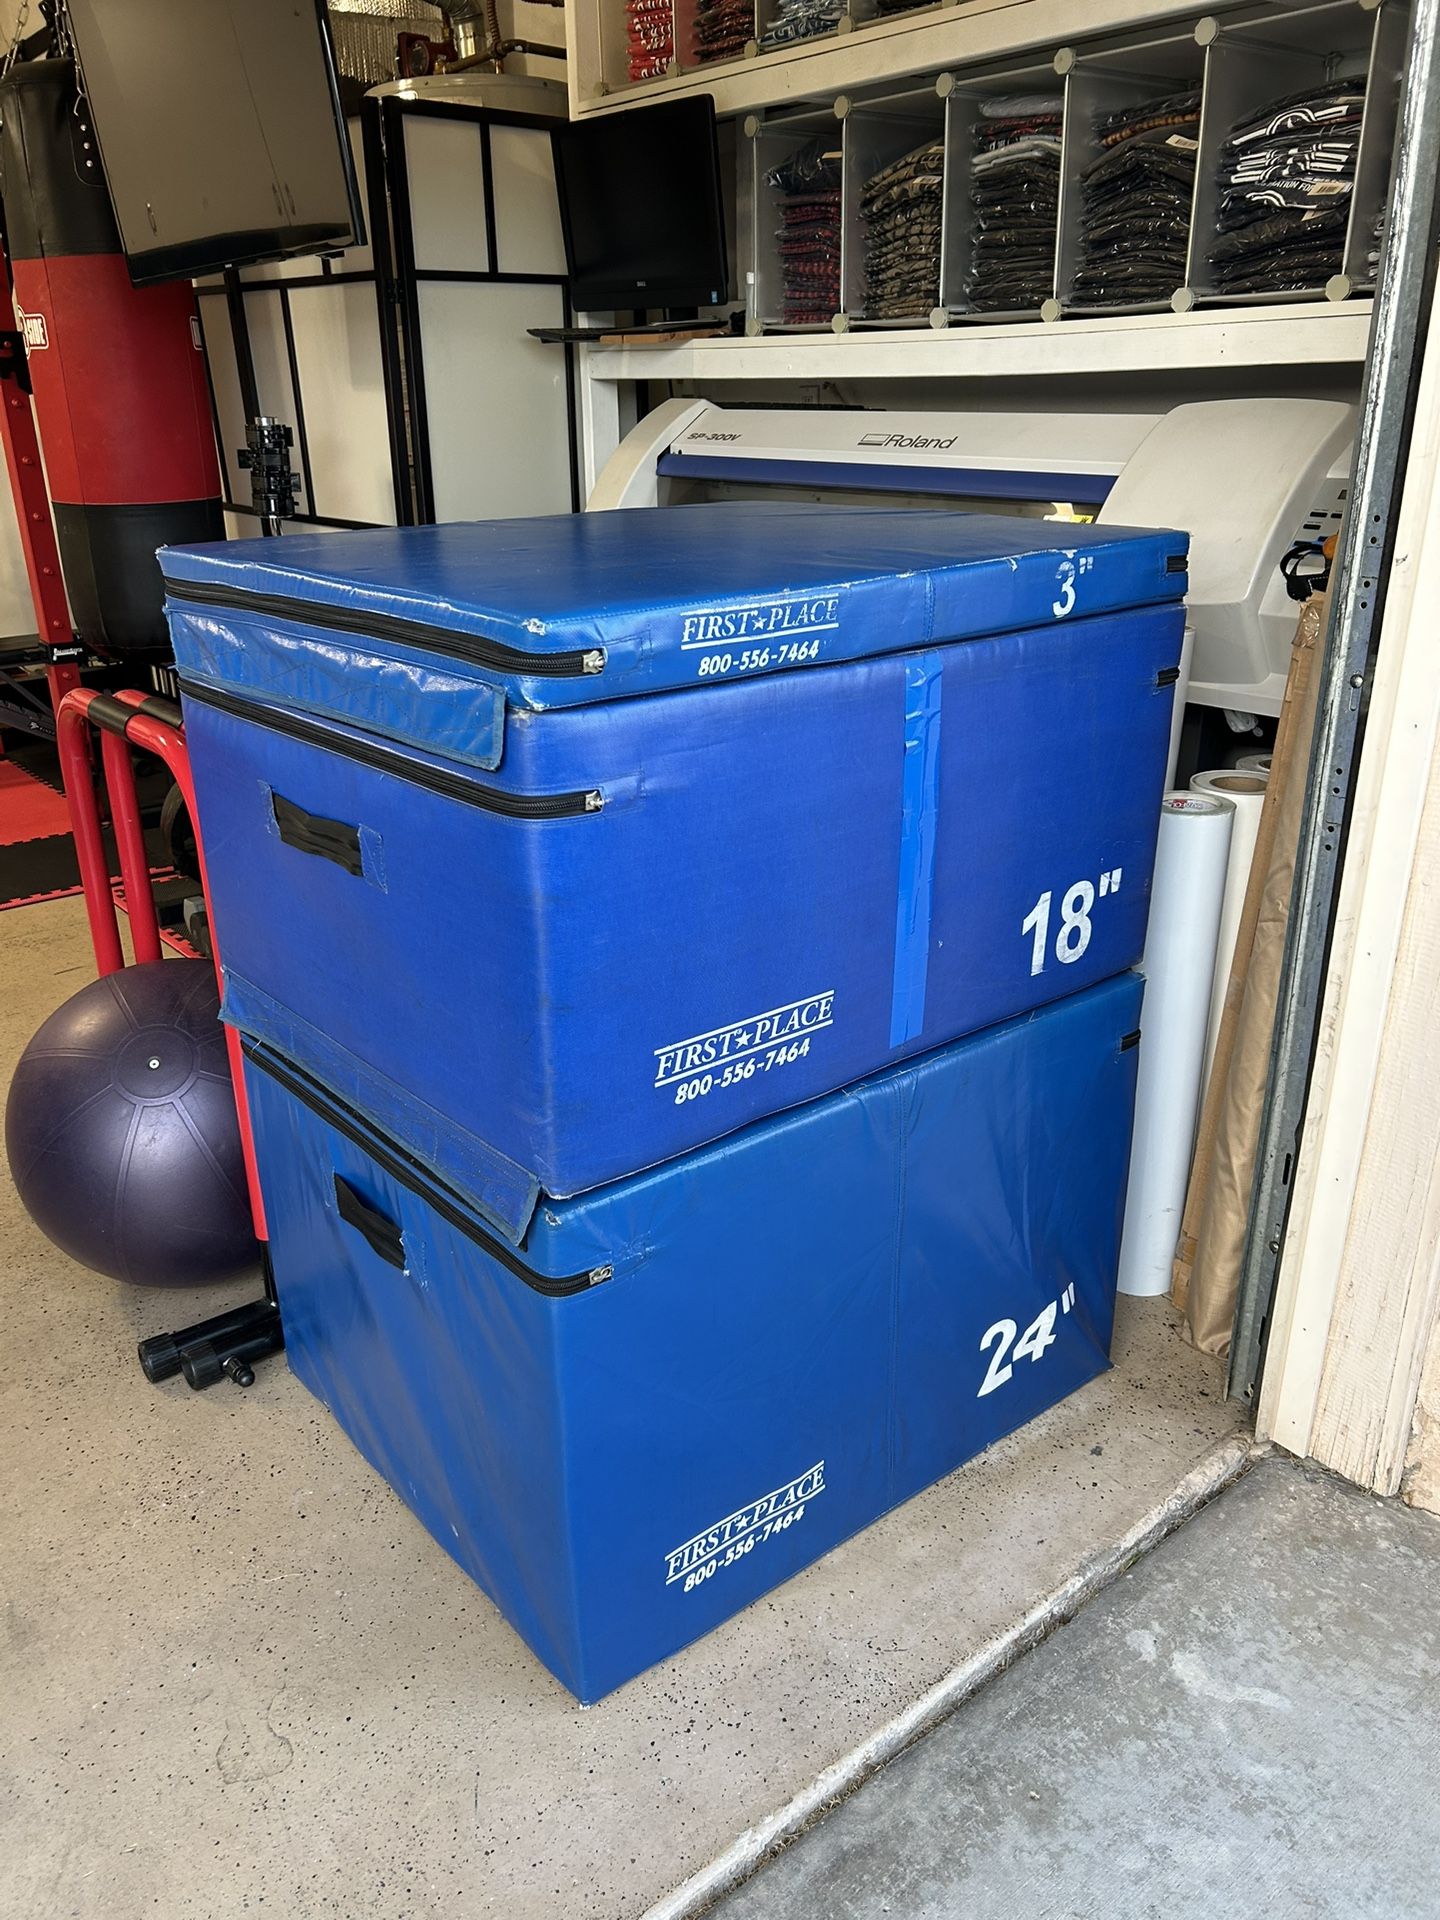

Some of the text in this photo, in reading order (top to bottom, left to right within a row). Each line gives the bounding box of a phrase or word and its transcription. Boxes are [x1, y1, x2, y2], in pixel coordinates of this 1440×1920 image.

[687, 432, 742, 442] SP-300V
[884, 434, 958, 449] Roland
[682, 600, 839, 643] FIRST PLACE
[698, 640, 820, 676] 800-556-7464
[1022, 867, 1122, 976] 18"
[655, 996, 834, 1081] FIRST PLACE
[675, 1038, 810, 1105] 800-556-7464
[977, 1281, 1076, 1398] 24"
[666, 1466, 824, 1580] FIRST PLACE
[683, 1505, 805, 1593] 800-556-7464
